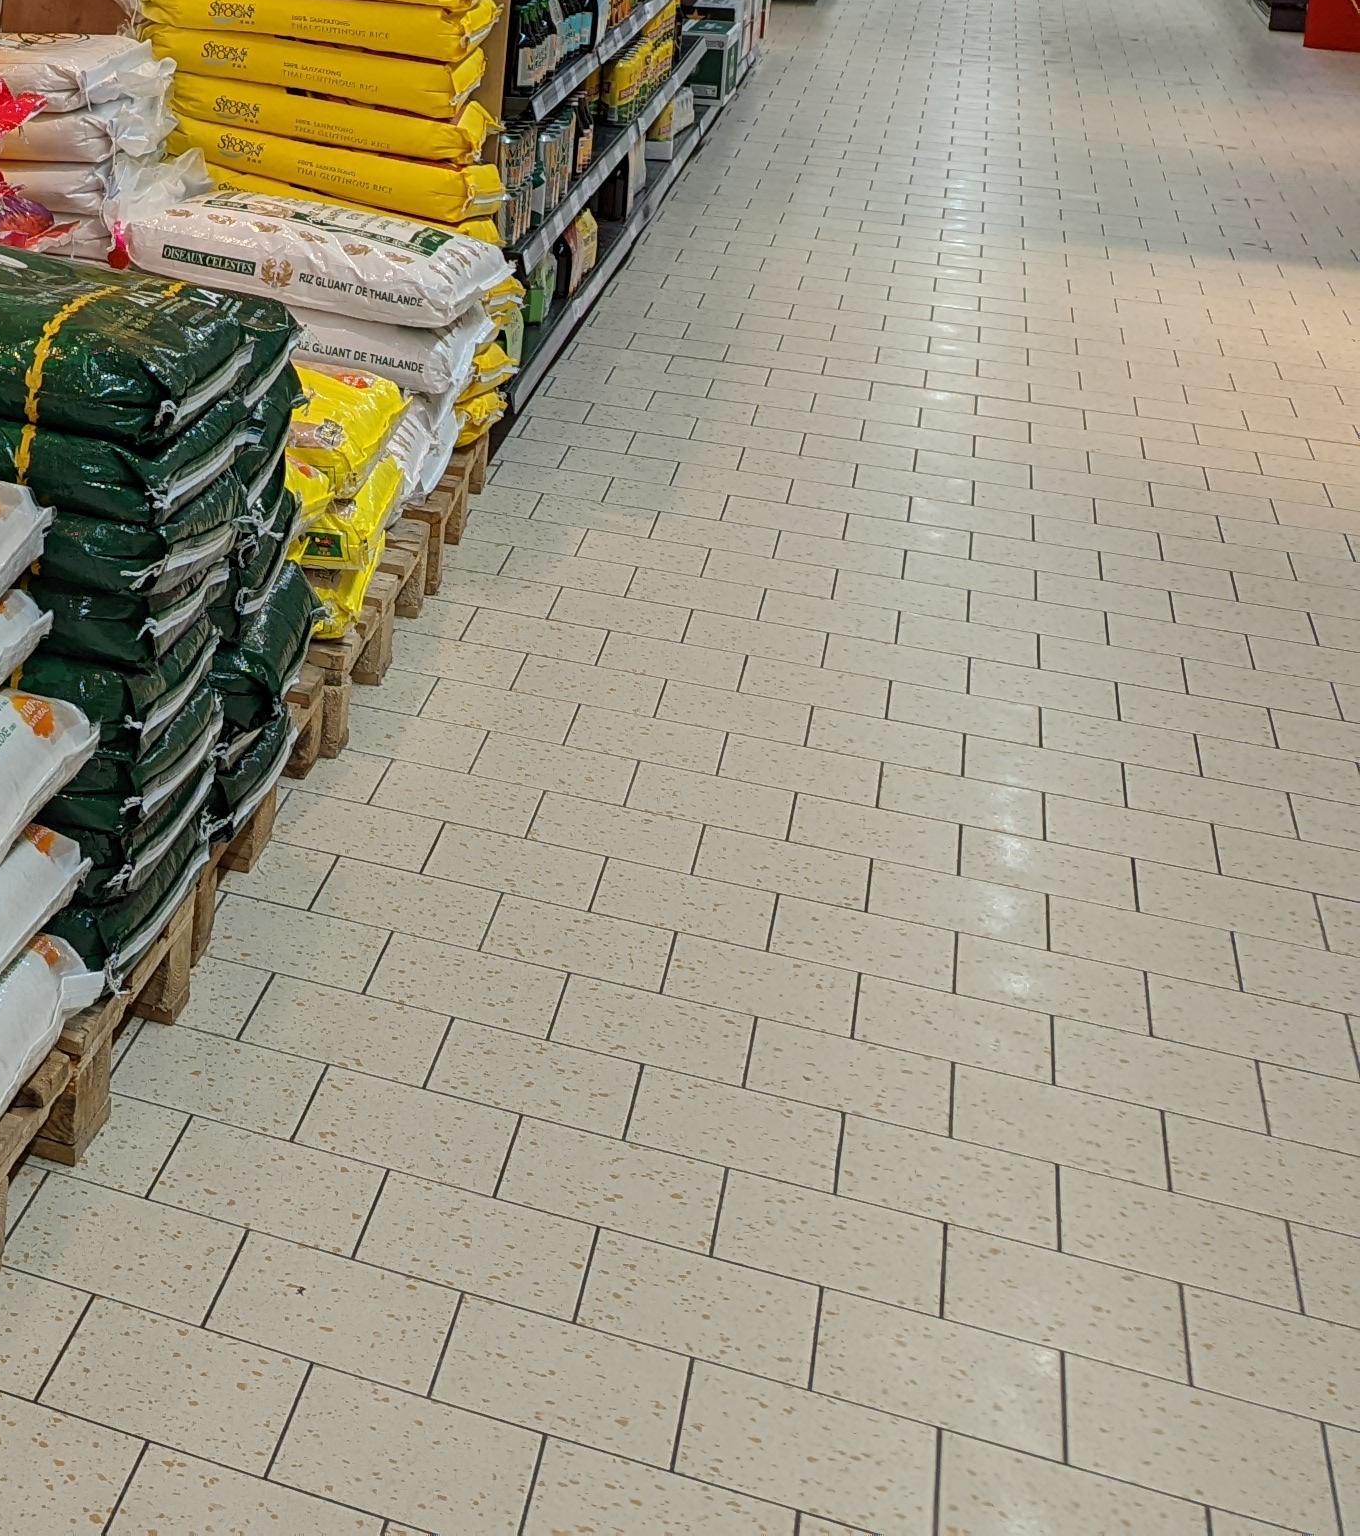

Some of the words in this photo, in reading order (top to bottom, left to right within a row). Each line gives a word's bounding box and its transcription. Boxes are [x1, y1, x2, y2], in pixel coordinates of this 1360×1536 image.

[164, 247, 204, 267] OISEAUX
[205, 254, 254, 274] CELESTES
[298, 273, 314, 285] RIZ
[315, 276, 353, 294] GLUANT
[355, 286, 369, 296] DE
